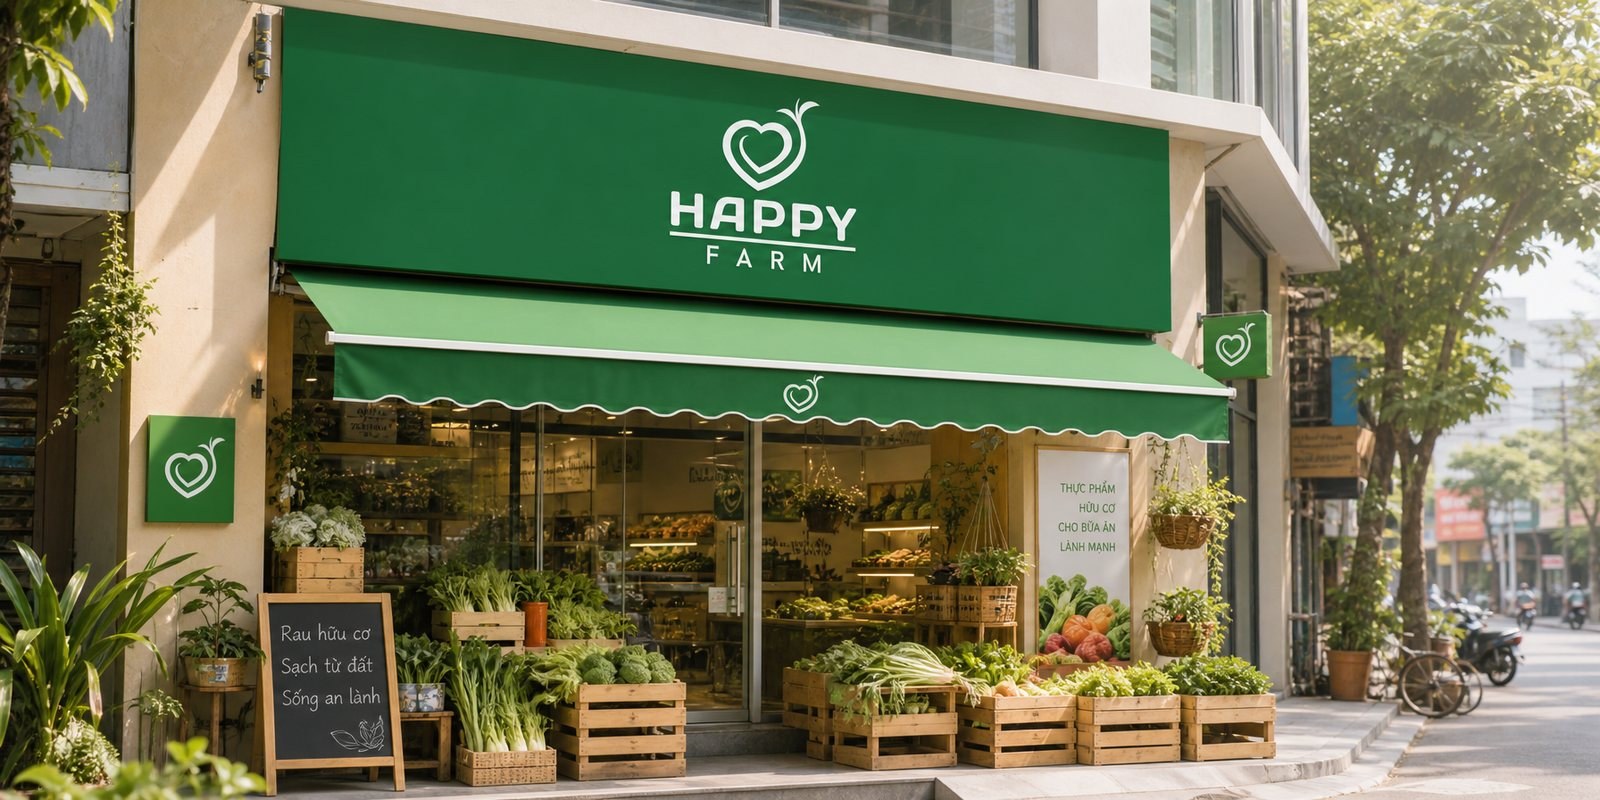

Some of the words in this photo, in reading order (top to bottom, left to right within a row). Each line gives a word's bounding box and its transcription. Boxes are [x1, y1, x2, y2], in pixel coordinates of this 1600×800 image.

[670, 191, 857, 242] HAPPY
[706, 245, 821, 273] FARM
[1061, 482, 1086, 495] THỰC
[1102, 503, 1116, 514] CƠ
[1058, 522, 1079, 533] CHO
[1087, 542, 1116, 554] MẠNH
[281, 625, 311, 641] Rau
[318, 623, 347, 641] hữu
[353, 628, 371, 641] cơ
[281, 656, 318, 677] Sạch
[324, 657, 342, 673] từ
[347, 655, 373, 673] đất
[282, 688, 319, 712] Sống
[325, 694, 343, 705] an
[350, 686, 381, 705] lành
